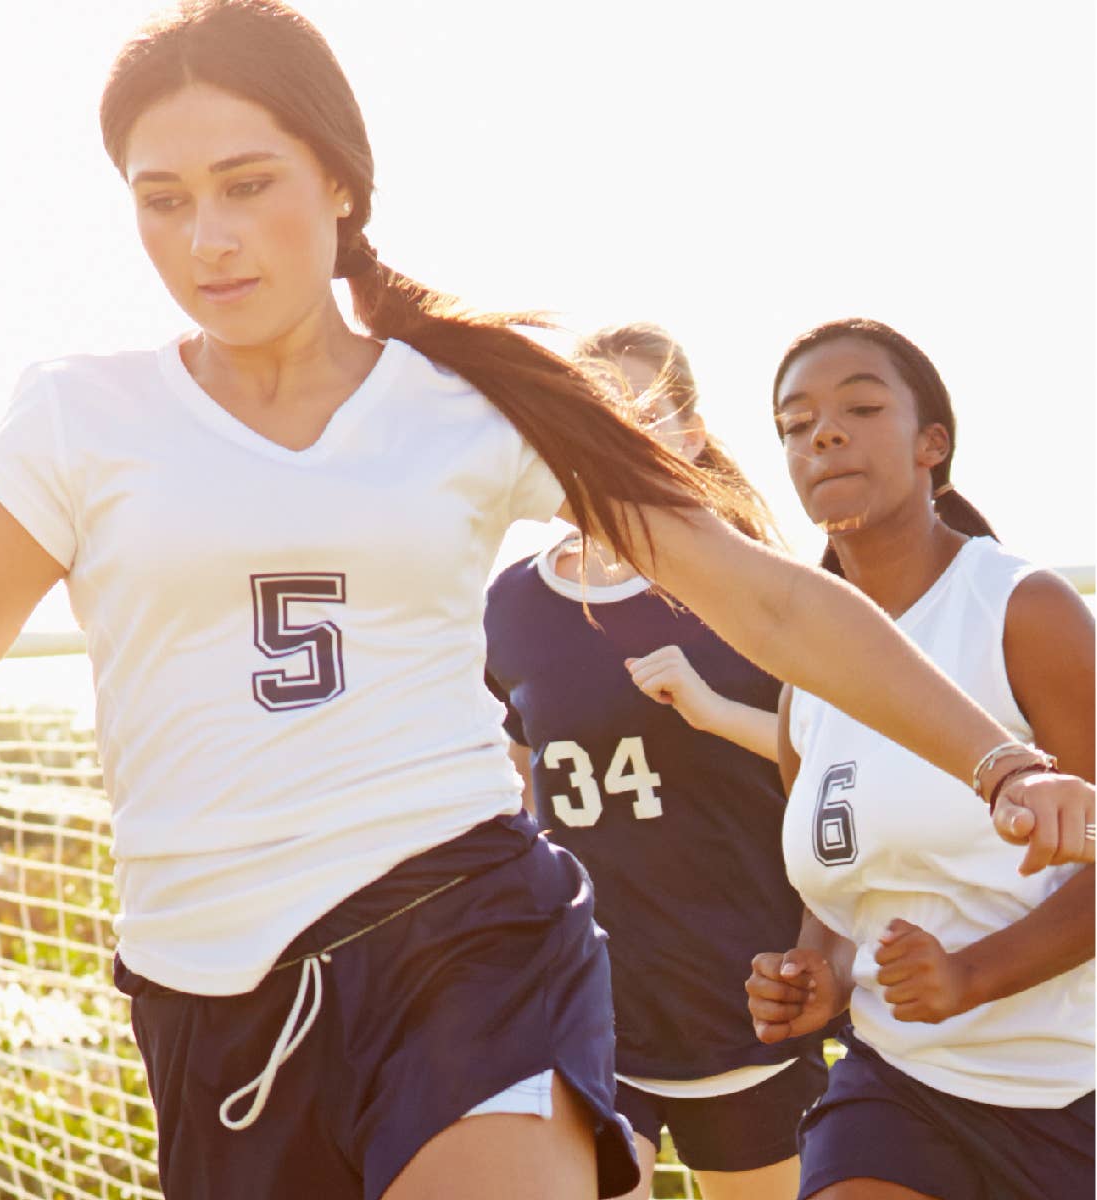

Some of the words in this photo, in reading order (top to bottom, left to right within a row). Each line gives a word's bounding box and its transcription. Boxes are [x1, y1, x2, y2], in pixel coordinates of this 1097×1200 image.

[249, 573, 346, 712] 5
[543, 735, 663, 828] 34
[812, 760, 858, 867] 6
